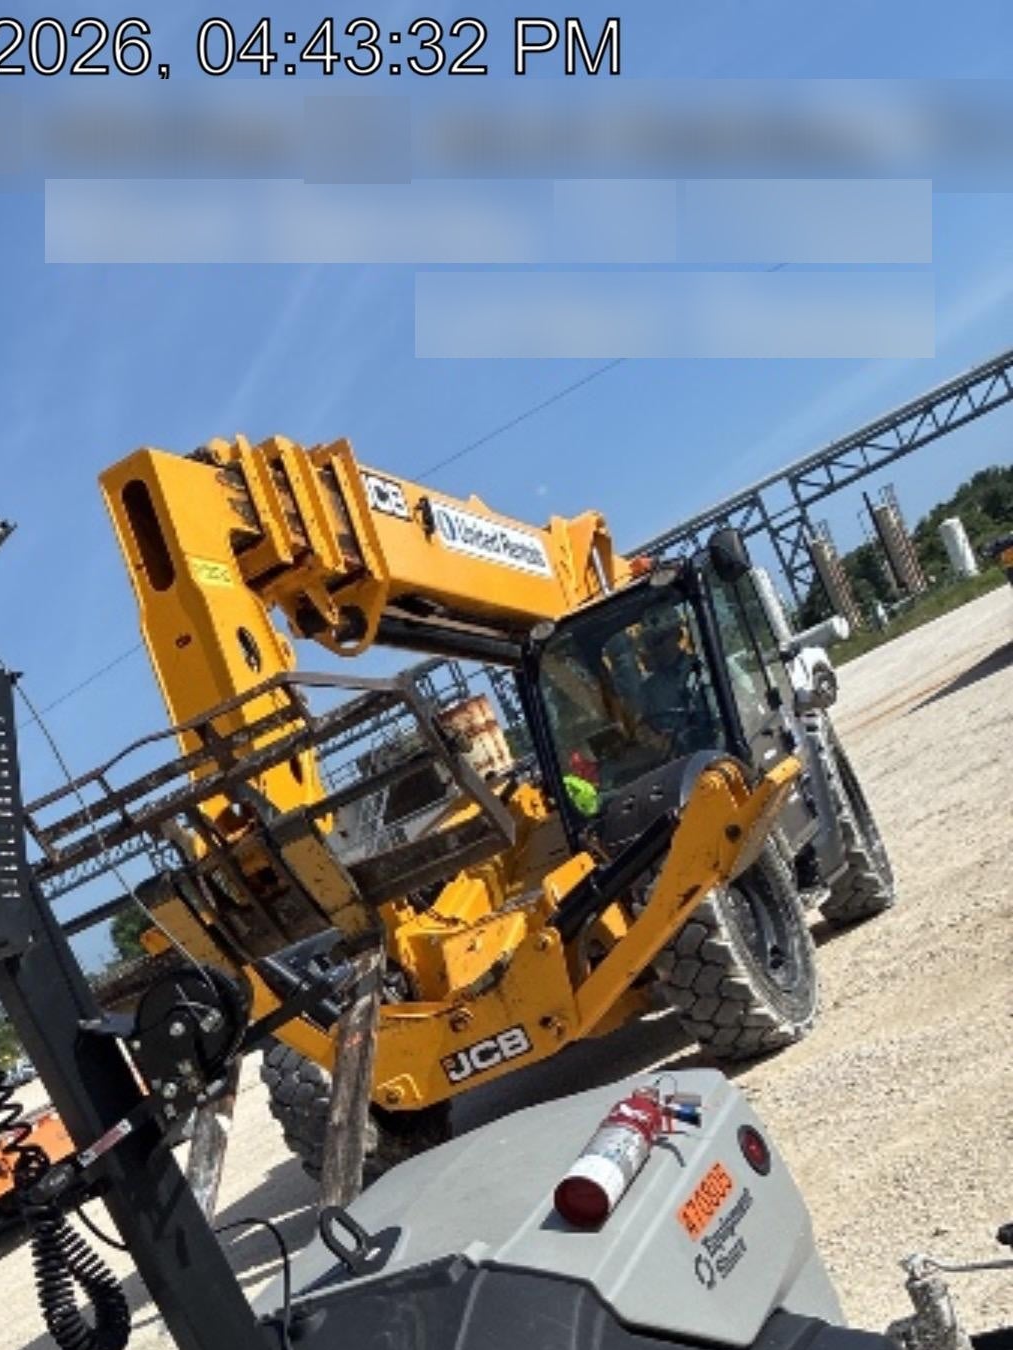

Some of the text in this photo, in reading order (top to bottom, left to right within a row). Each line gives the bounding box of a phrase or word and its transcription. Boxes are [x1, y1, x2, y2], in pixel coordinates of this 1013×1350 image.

[456, 514, 546, 568] United Rentals
[442, 1026, 531, 1082] JCB
